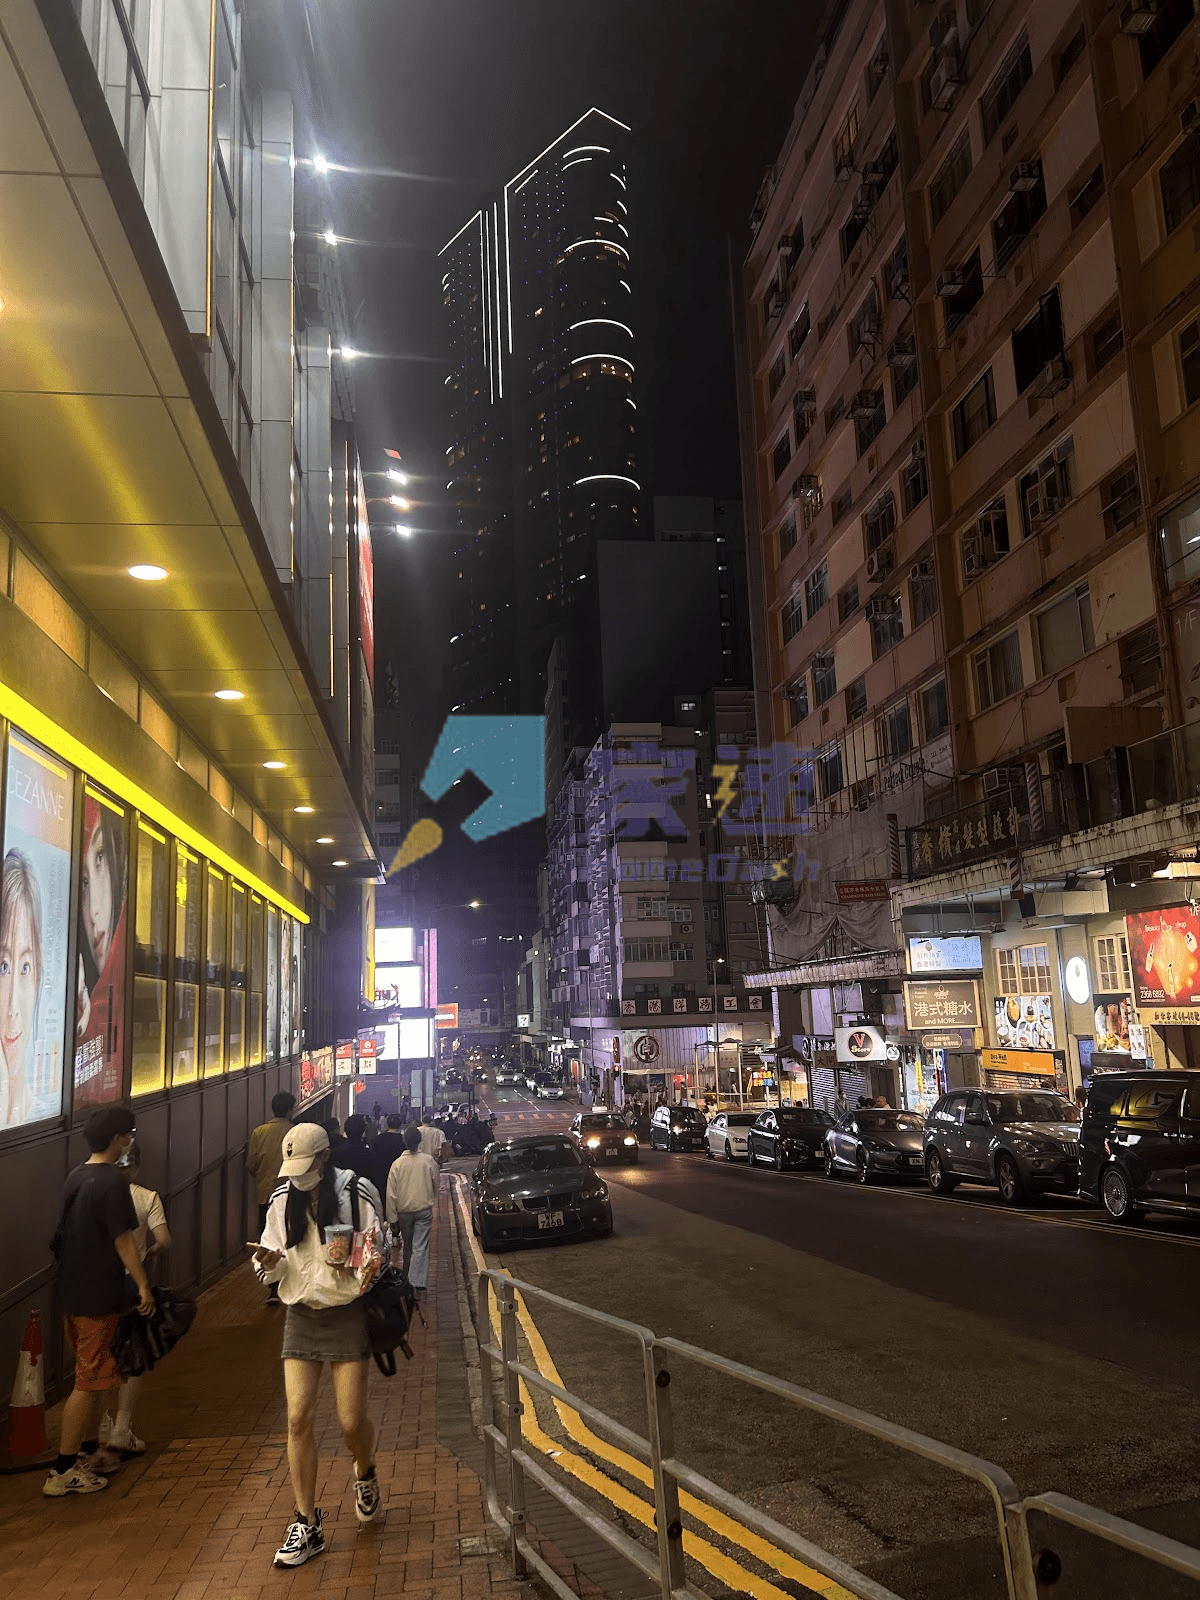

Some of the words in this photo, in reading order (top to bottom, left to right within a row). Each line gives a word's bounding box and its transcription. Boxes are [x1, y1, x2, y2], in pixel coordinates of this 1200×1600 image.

[1175, 609, 1197, 636] 1/F
[913, 1000, 973, 1017] 港式糖水
[853, 1033, 866, 1047] V
